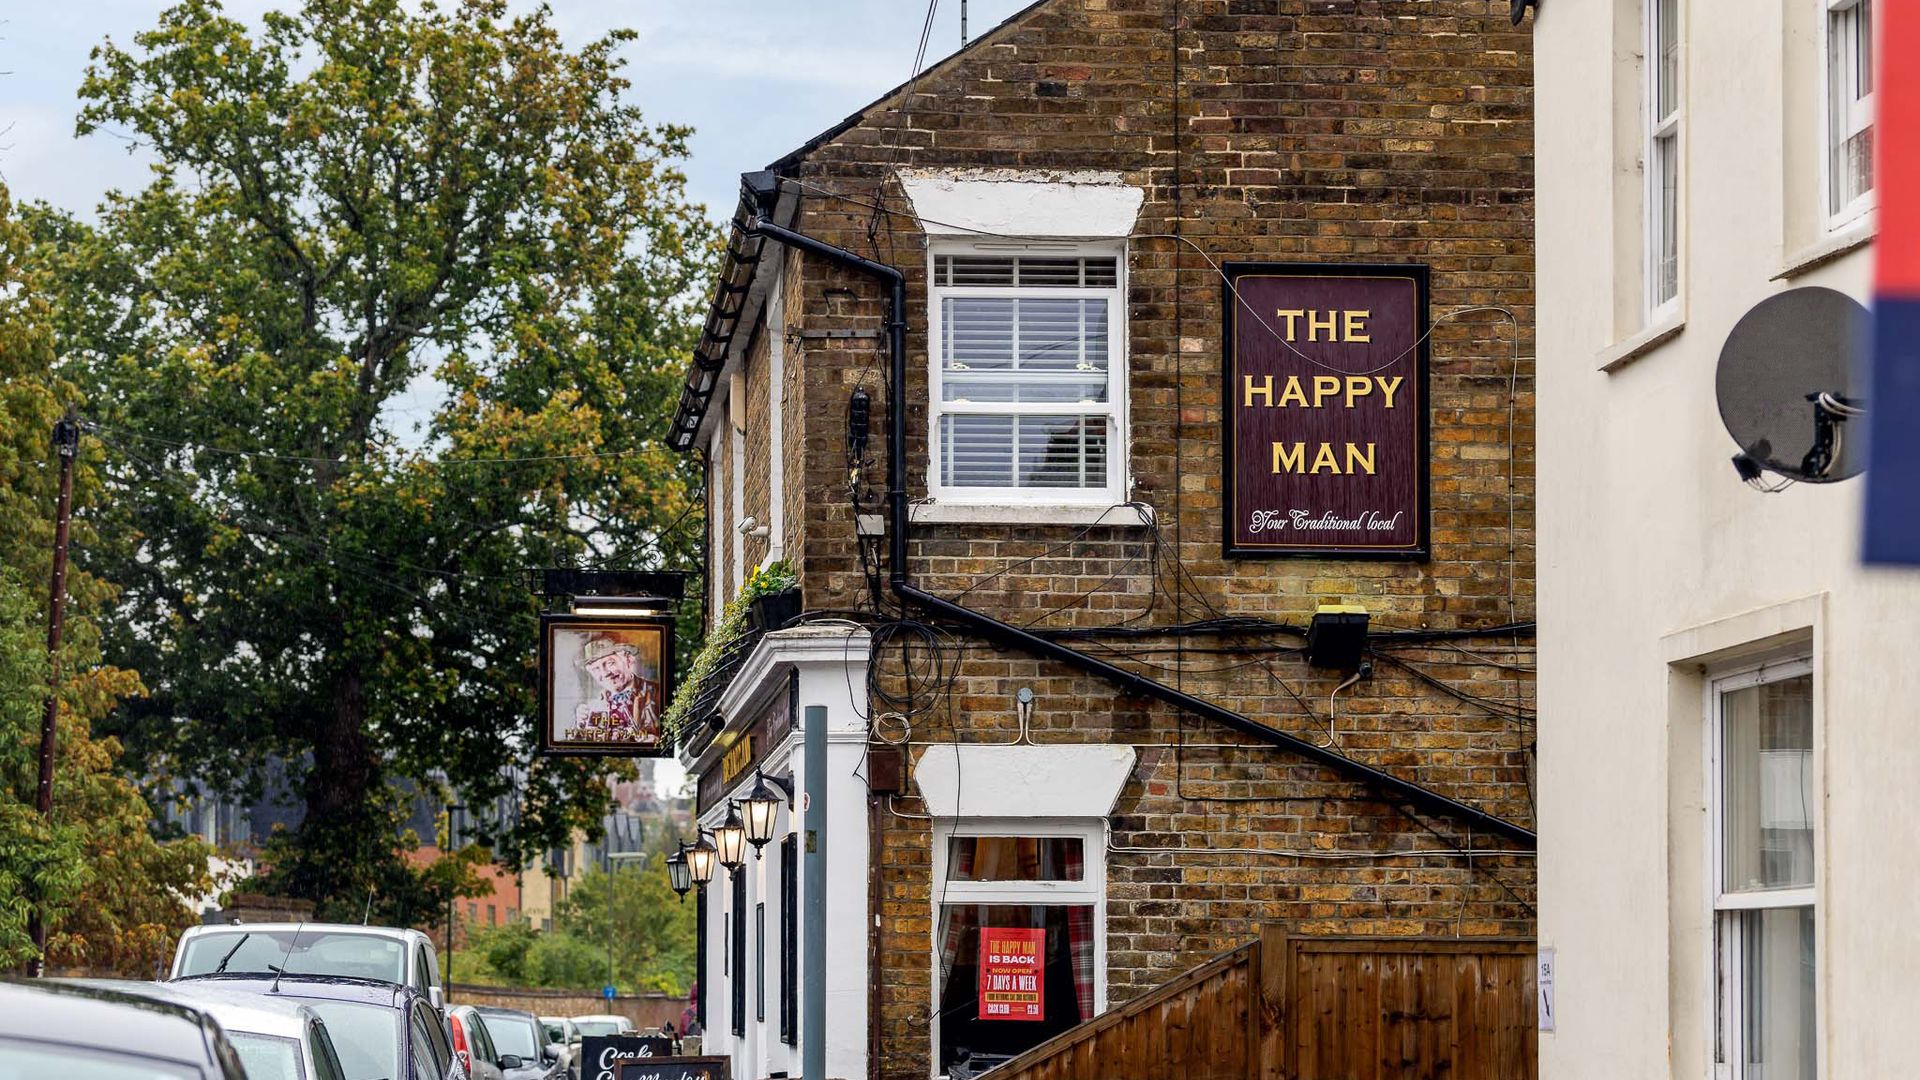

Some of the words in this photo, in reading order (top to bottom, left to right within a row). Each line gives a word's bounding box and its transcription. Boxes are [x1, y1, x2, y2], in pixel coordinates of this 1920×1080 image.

[1277, 309, 1370, 343] THE
[1244, 375, 1404, 409] HAPPY
[1272, 442, 1376, 475] MAN
[1249, 509, 1288, 534] Your
[1289, 509, 1369, 530] Traditional
[1367, 510, 1403, 530] local
[592, 716, 619, 726] THE
[565, 728, 612, 739] HAPPY
[616, 728, 649, 739] MAN
[990, 940, 1000, 954] THE
[1002, 940, 1021, 955] HAPPY
[1023, 941, 1036, 955] MAN
[990, 955, 1000, 963] IS
[1002, 955, 1035, 964] BACK
[987, 975, 992, 990] 7
[993, 975, 1010, 990] DAYS
[1012, 975, 1016, 990] A
[1019, 975, 1036, 991] WEEK
